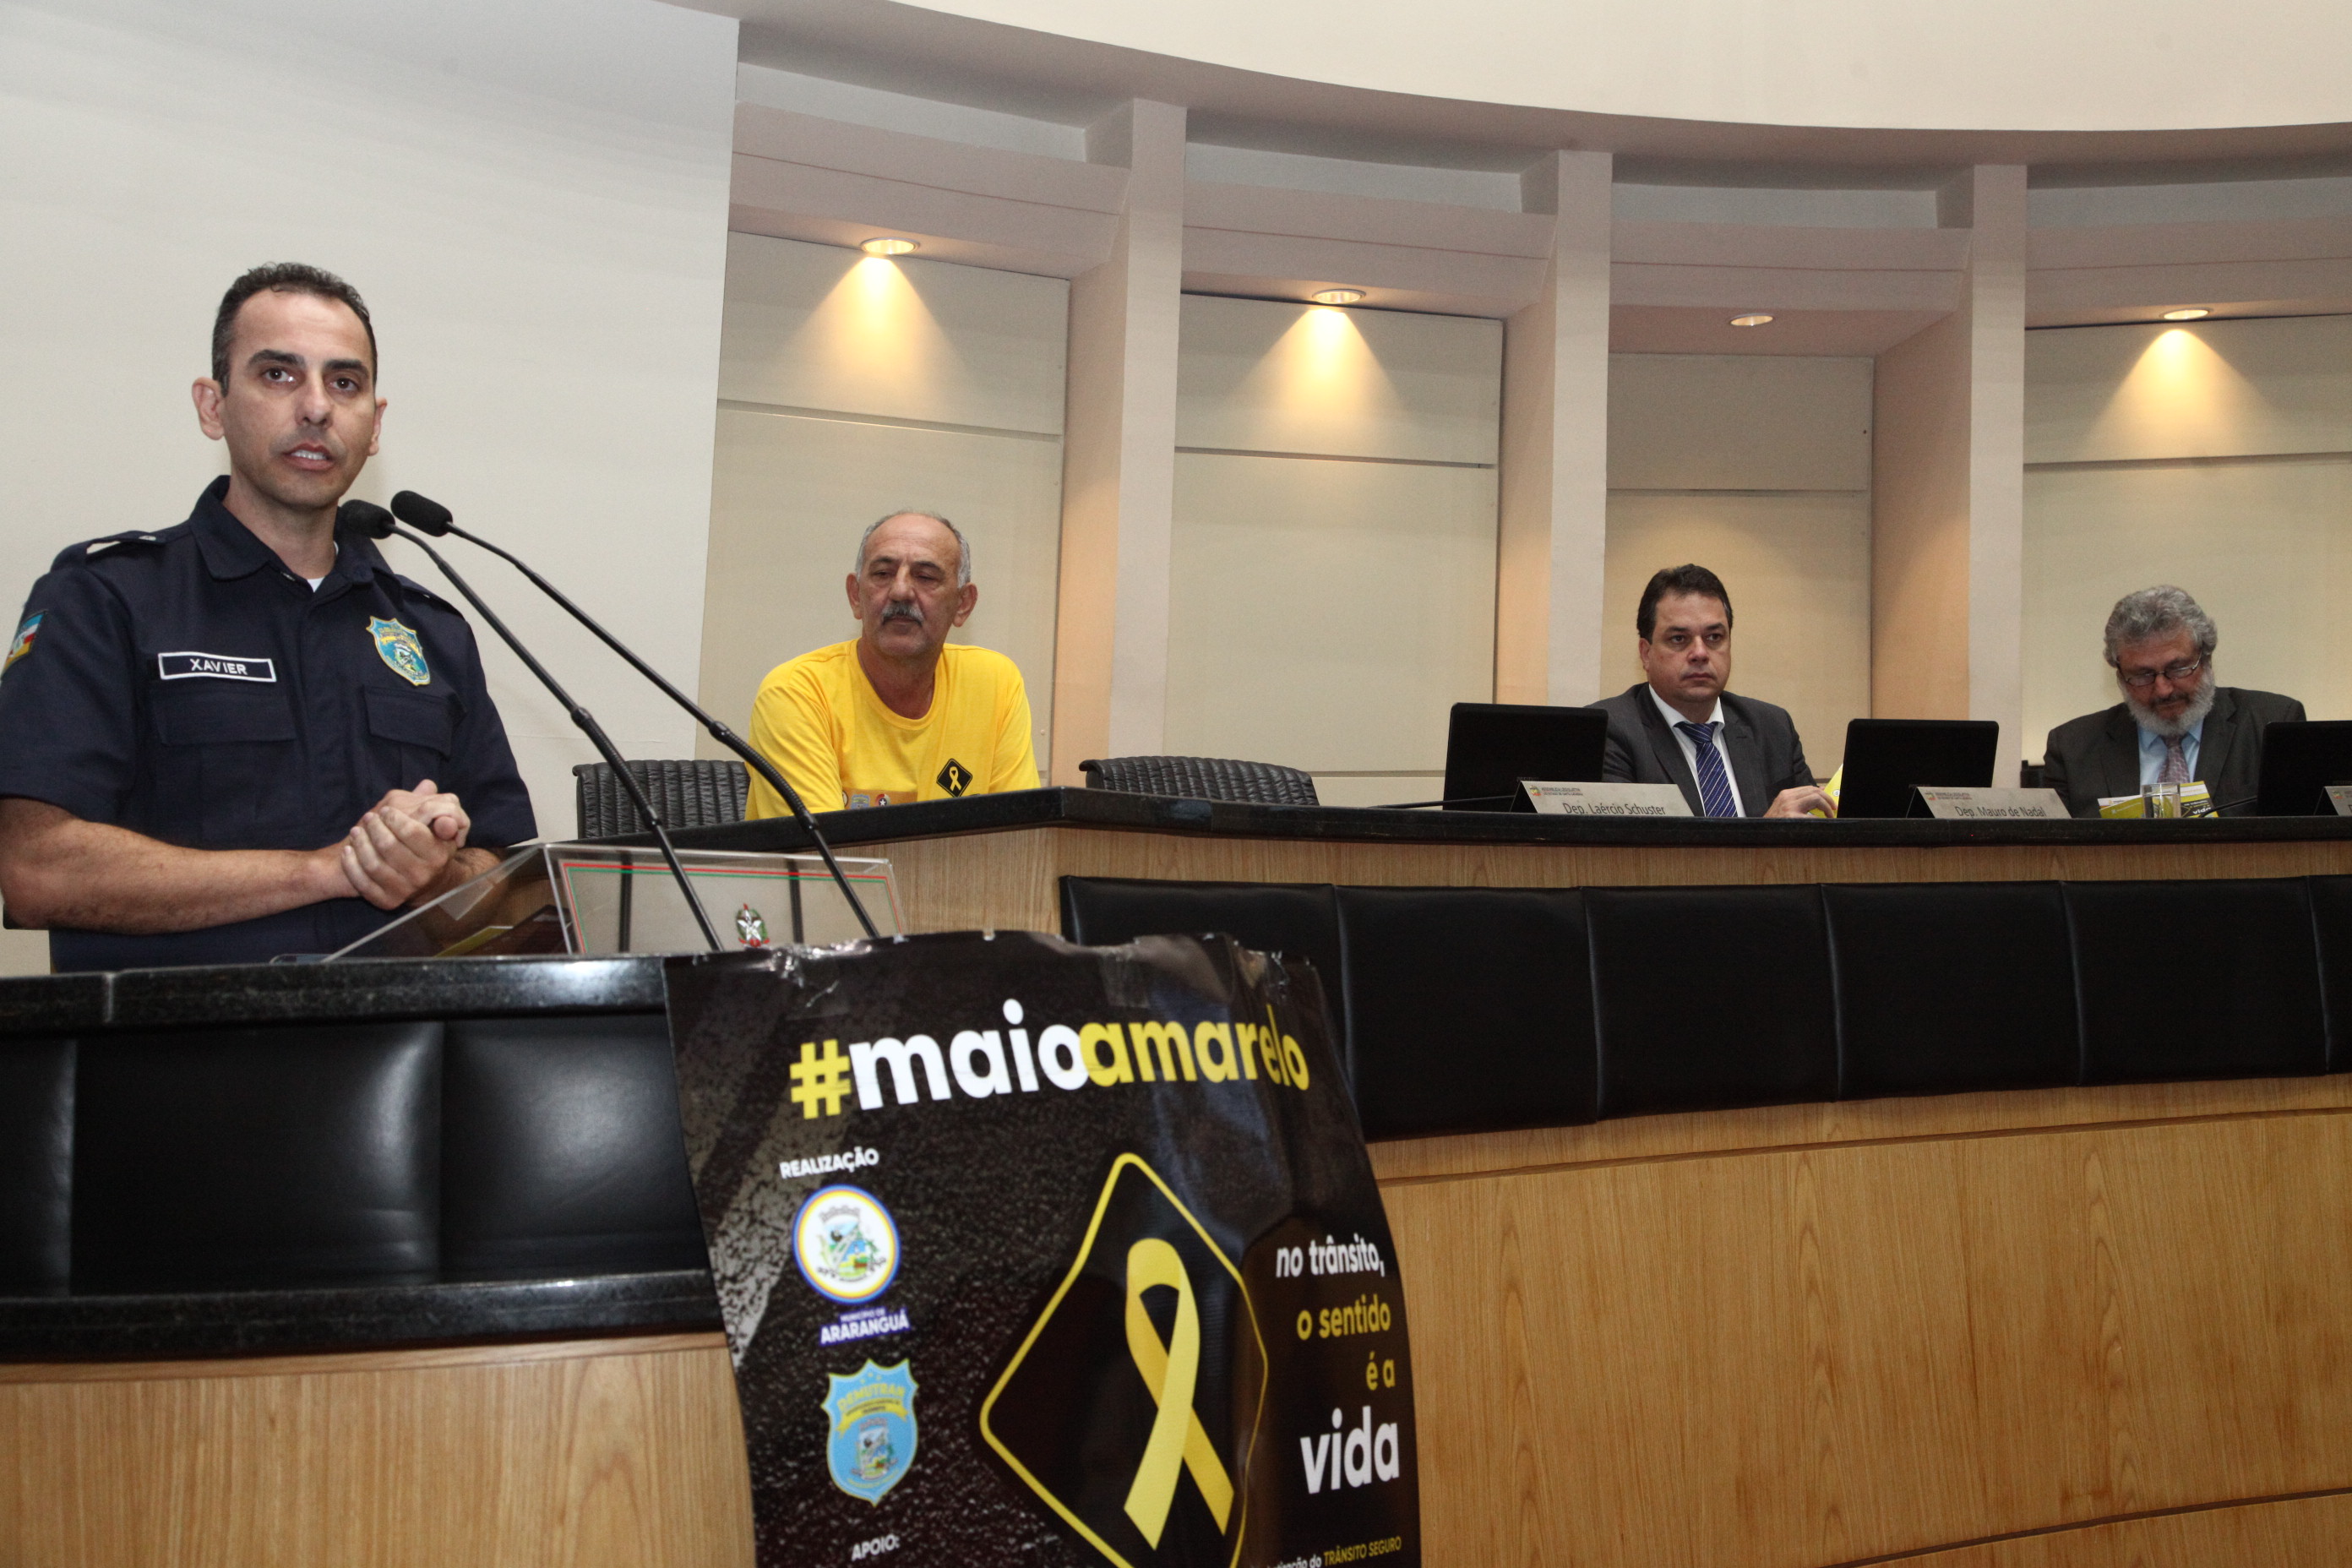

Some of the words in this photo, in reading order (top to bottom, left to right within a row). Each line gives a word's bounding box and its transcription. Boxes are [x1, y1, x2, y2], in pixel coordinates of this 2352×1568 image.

[190, 658, 248, 675] XAVIER
[1563, 803, 1587, 815] Dep.
[1589, 803, 1625, 815] Laércio
[1625, 803, 1666, 815] Schuster
[1954, 806, 1978, 819] Dep.
[1978, 807, 2007, 817] Mauro
[2008, 806, 2019, 817] de
[2020, 806, 2047, 818] Nadal
[779, 1146, 879, 1179] REALIZAÇÃO
[1276, 1244, 1304, 1278] no
[1309, 1233, 1386, 1277] trânsito,
[820, 1308, 910, 1344] ARARANGUÁ
[1297, 1309, 1313, 1341] o
[1319, 1293, 1391, 1340] sentido
[1365, 1351, 1379, 1391] é
[1383, 1358, 1396, 1388] a
[1299, 1405, 1401, 1495] vida
[852, 1533, 901, 1562] APOIO:
[1323, 1543, 1368, 1565] TRÂNSITO
[1369, 1536, 1402, 1557] SEGURO
